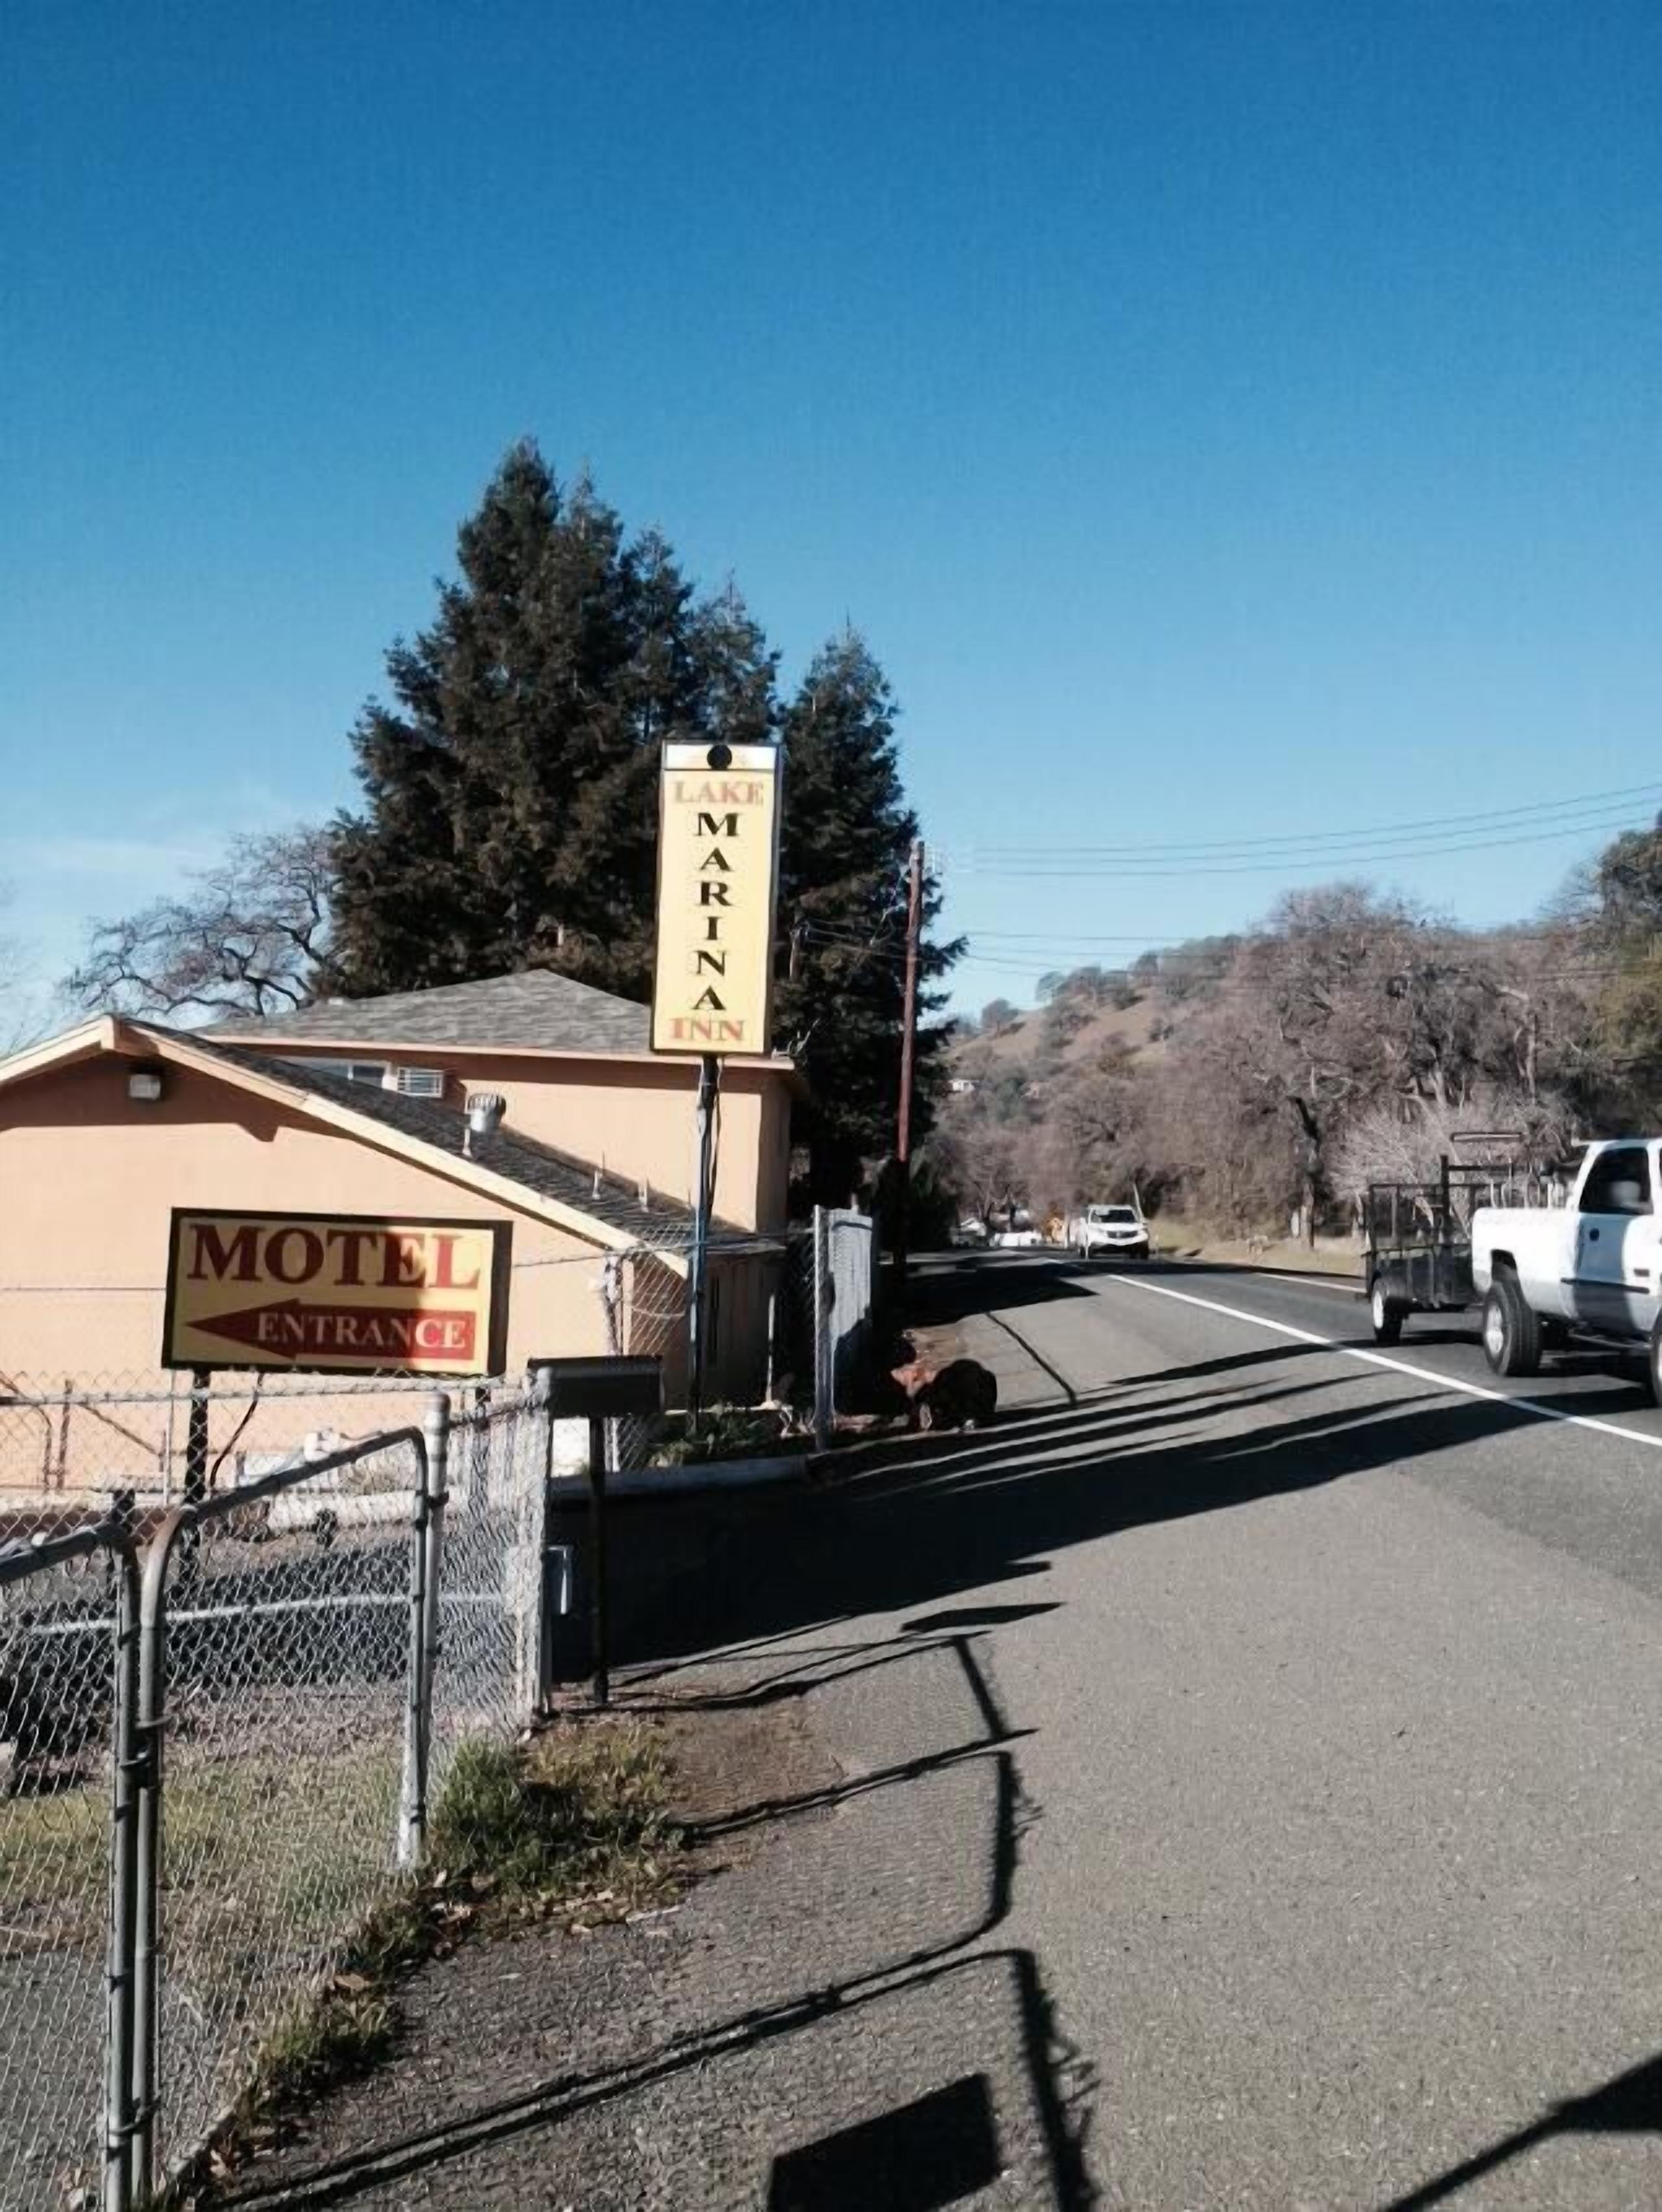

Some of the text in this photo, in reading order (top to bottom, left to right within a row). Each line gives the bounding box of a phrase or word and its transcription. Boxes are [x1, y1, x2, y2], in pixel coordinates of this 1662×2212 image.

[673, 781, 763, 804] LAKE
[693, 812, 739, 1011] MARINA
[669, 1018, 744, 1040] INN
[187, 1224, 480, 1289] MOTEL
[256, 1312, 465, 1349] ENTRANCE
